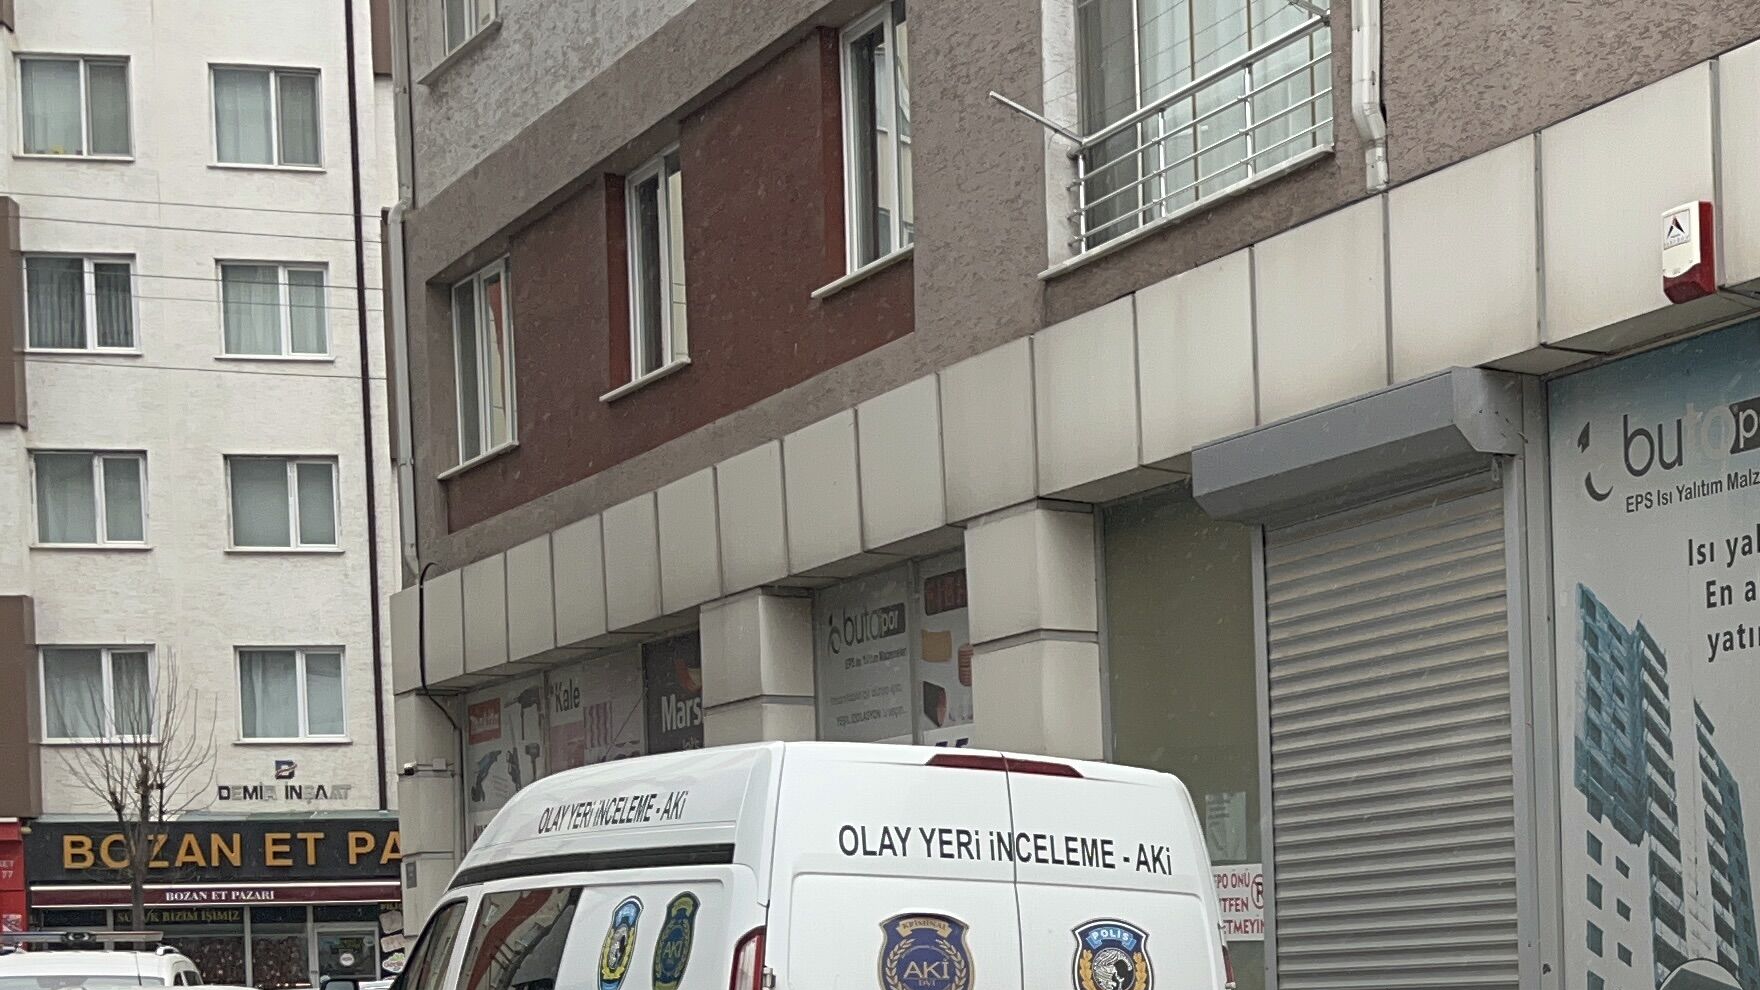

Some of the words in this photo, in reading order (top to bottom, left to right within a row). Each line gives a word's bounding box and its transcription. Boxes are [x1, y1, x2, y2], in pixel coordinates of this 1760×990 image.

[1625, 491, 1654, 513] EPS
[1676, 478, 1723, 504] Yalıtım
[1688, 538, 1715, 566] Isı
[1705, 579, 1733, 609] En
[555, 678, 581, 713] Kale
[661, 694, 702, 733] Mars
[538, 804, 570, 835] OLAY
[62, 832, 243, 871] BOZAN
[264, 831, 326, 868] ET
[838, 824, 912, 857] OLAY
[165, 891, 208, 901] BOZAN
[211, 890, 228, 900] ET
[903, 958, 950, 979] AKİ
